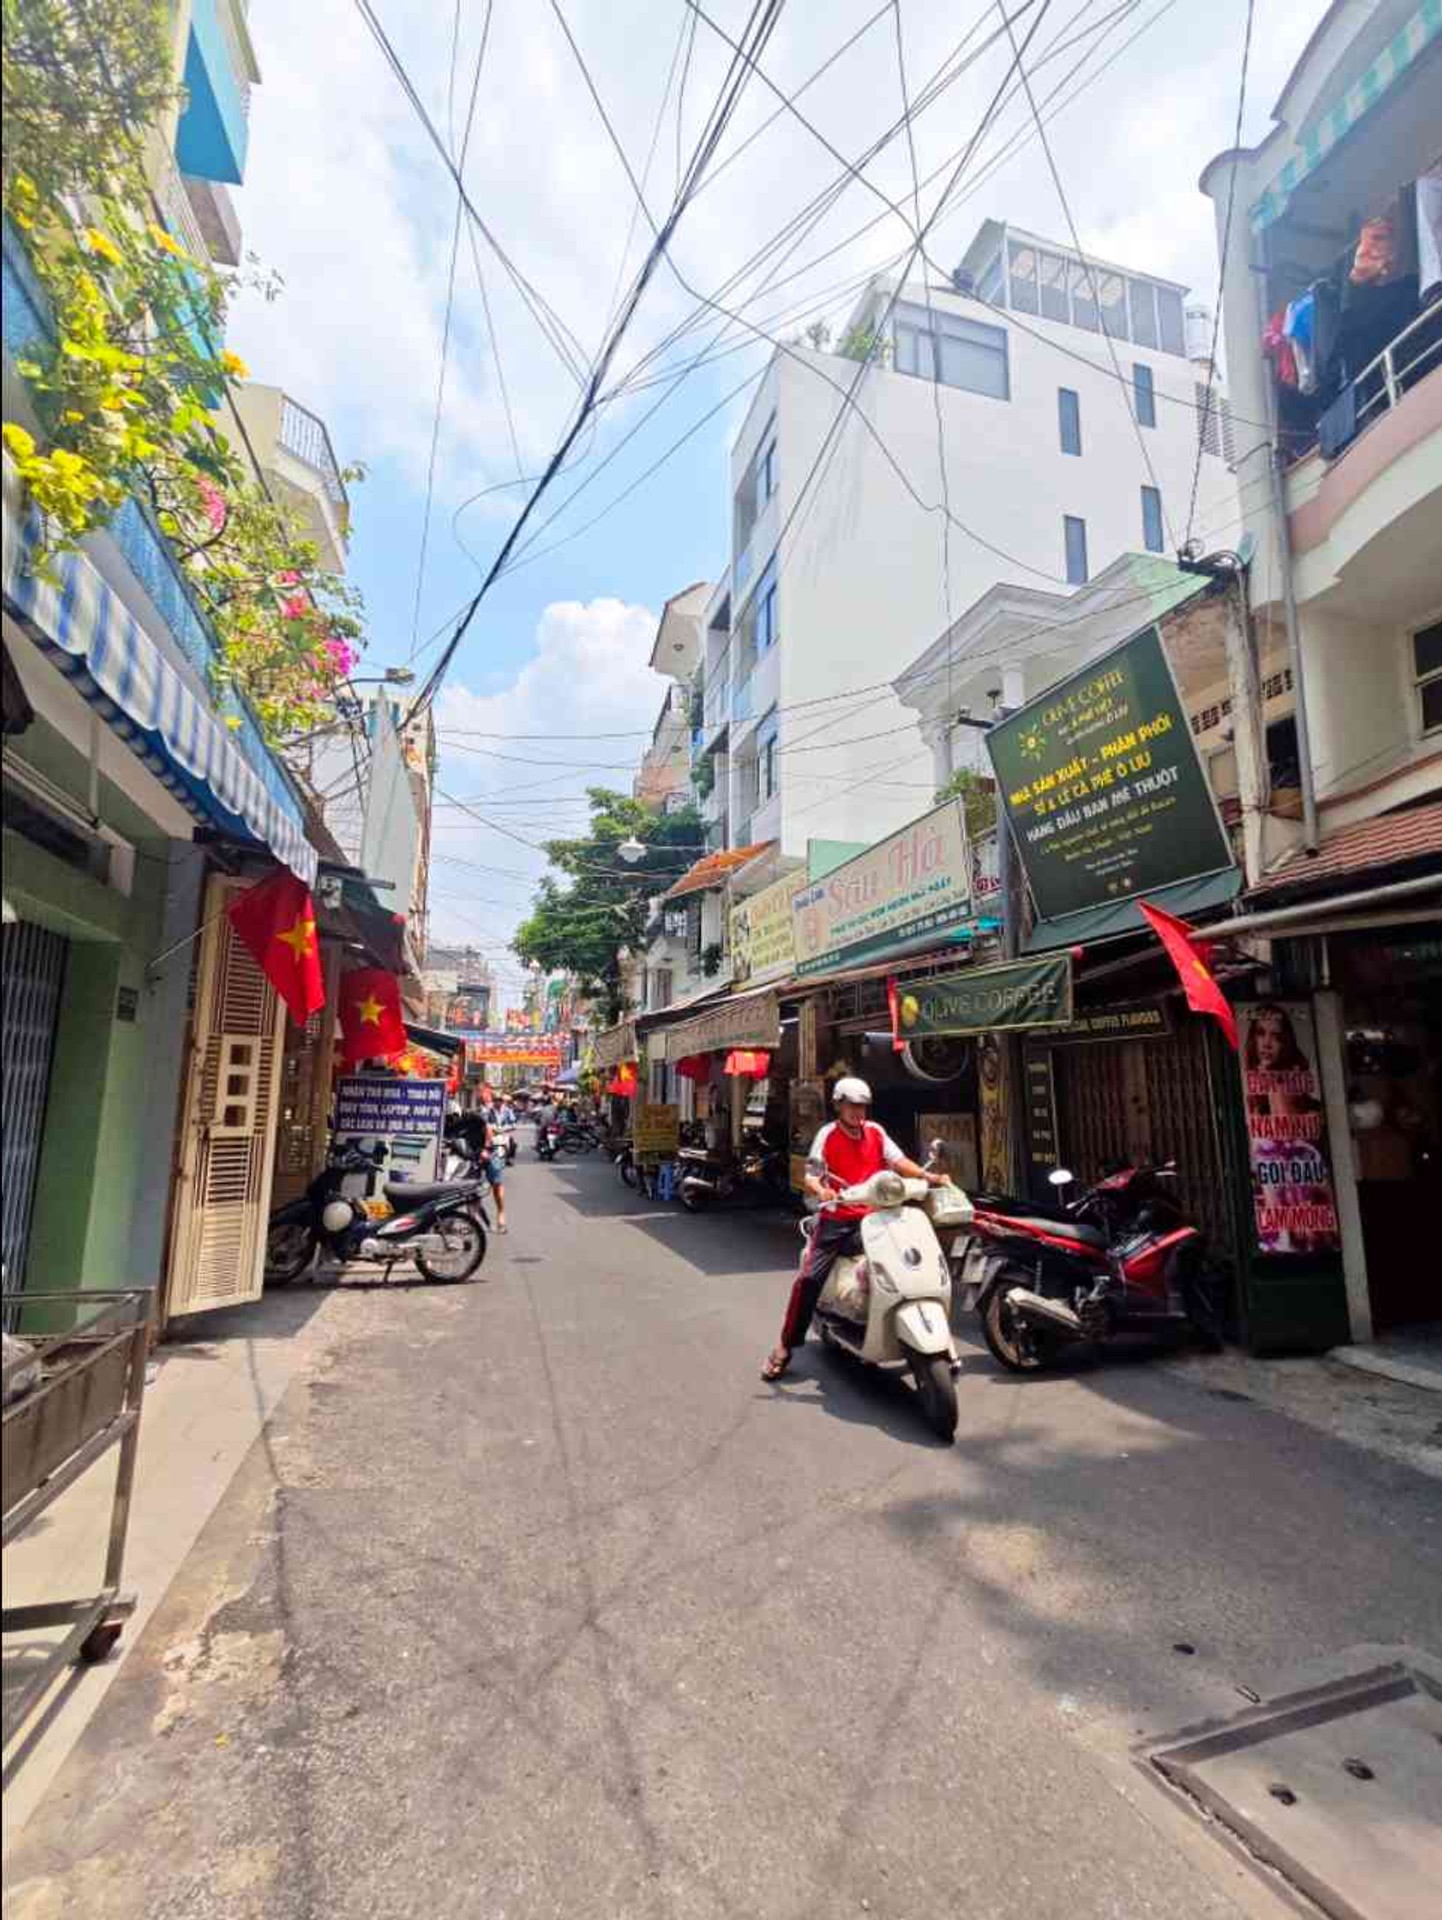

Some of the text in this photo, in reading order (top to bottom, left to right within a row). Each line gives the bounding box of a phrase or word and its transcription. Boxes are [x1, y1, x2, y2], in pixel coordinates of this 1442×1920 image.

[1056, 756, 1088, 784] XUẤT
[1101, 733, 1136, 760] PHÂN
[1138, 712, 1172, 742] PHỐI
[1073, 778, 1090, 798] CÀ
[1091, 767, 1114, 789] PHÊ
[1129, 751, 1152, 773] LIU
[1135, 766, 1178, 795] THUỘT
[888, 826, 944, 886] Hà
